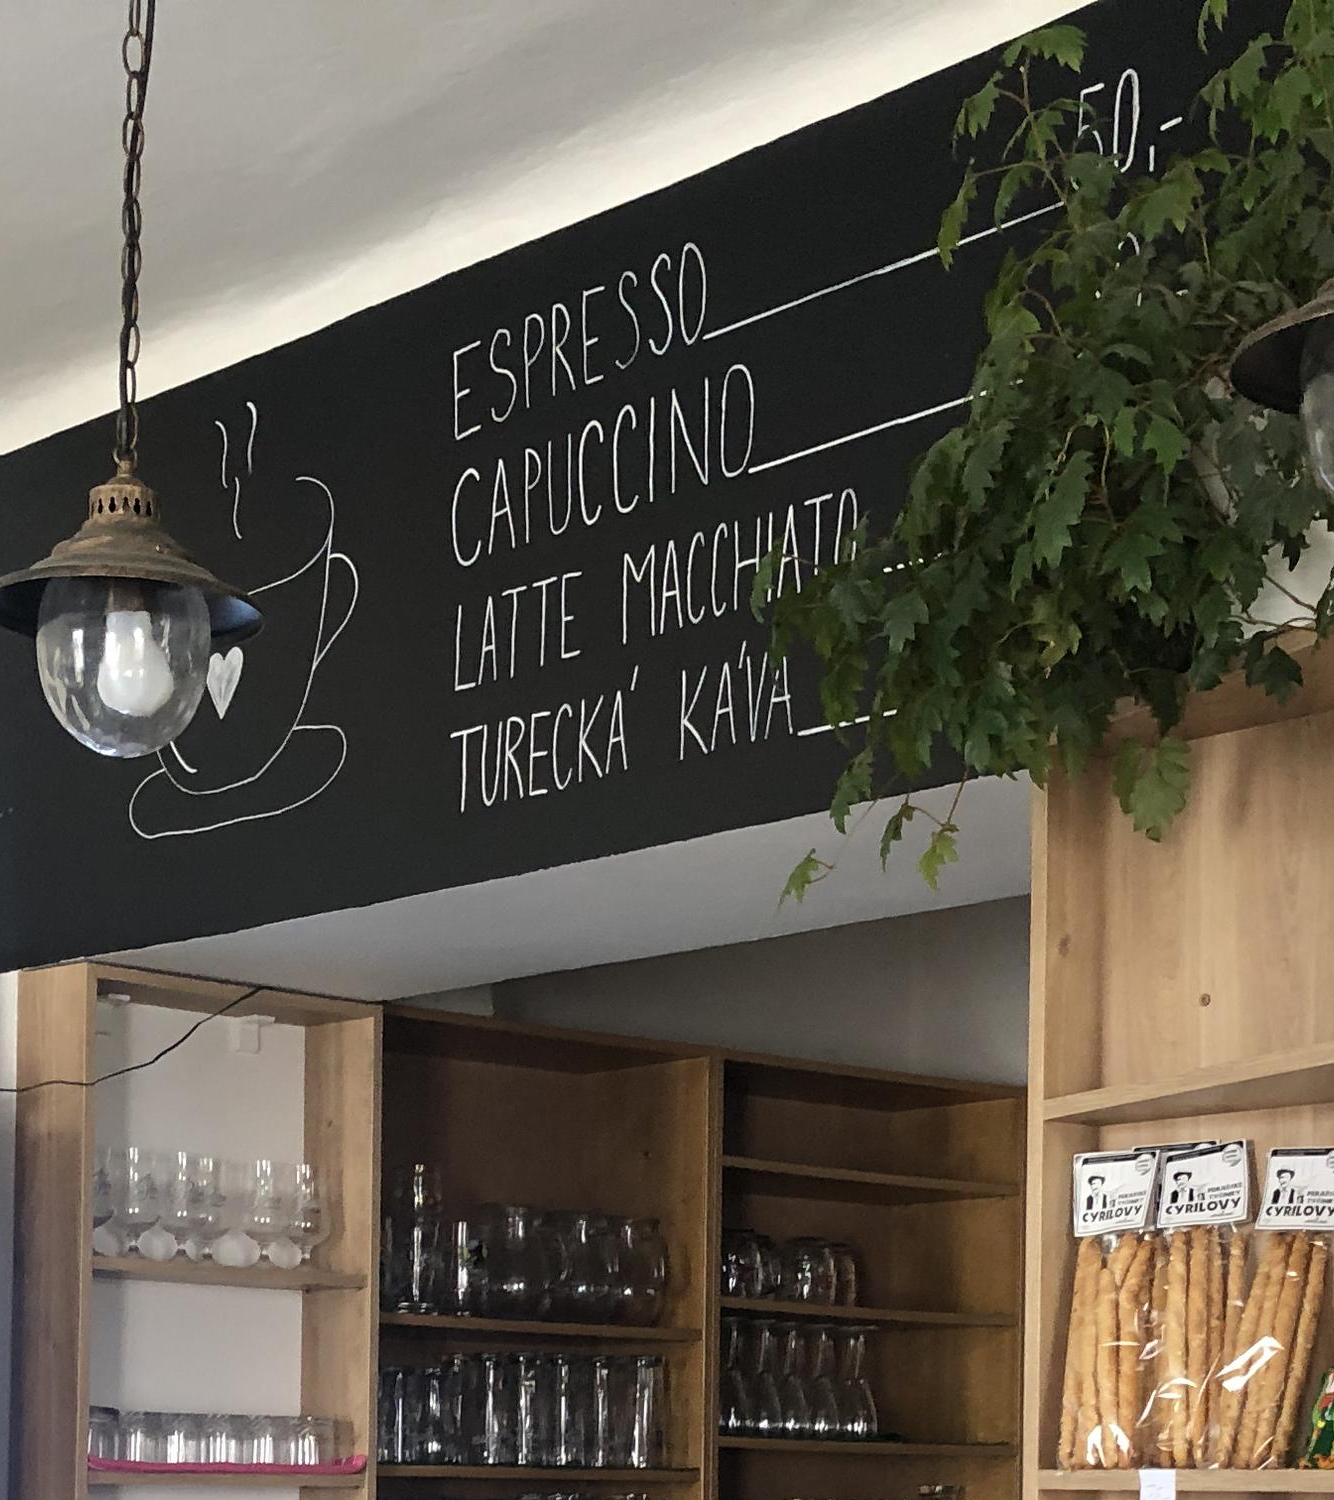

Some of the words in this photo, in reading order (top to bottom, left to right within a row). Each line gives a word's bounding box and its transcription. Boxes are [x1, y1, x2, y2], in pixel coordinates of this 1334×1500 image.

[452, 240, 708, 442] ESPRESSO
[451, 362, 755, 568] CAPUCCINO
[454, 570, 583, 693] LATTE
[621, 487, 858, 645] MACCHIATO
[450, 665, 640, 813] TURECKÁ
[679, 640, 794, 761] KÁVA
[1082, 1204, 1143, 1223] CYRILOVY
[1165, 1197, 1241, 1215] CYRILOVY
